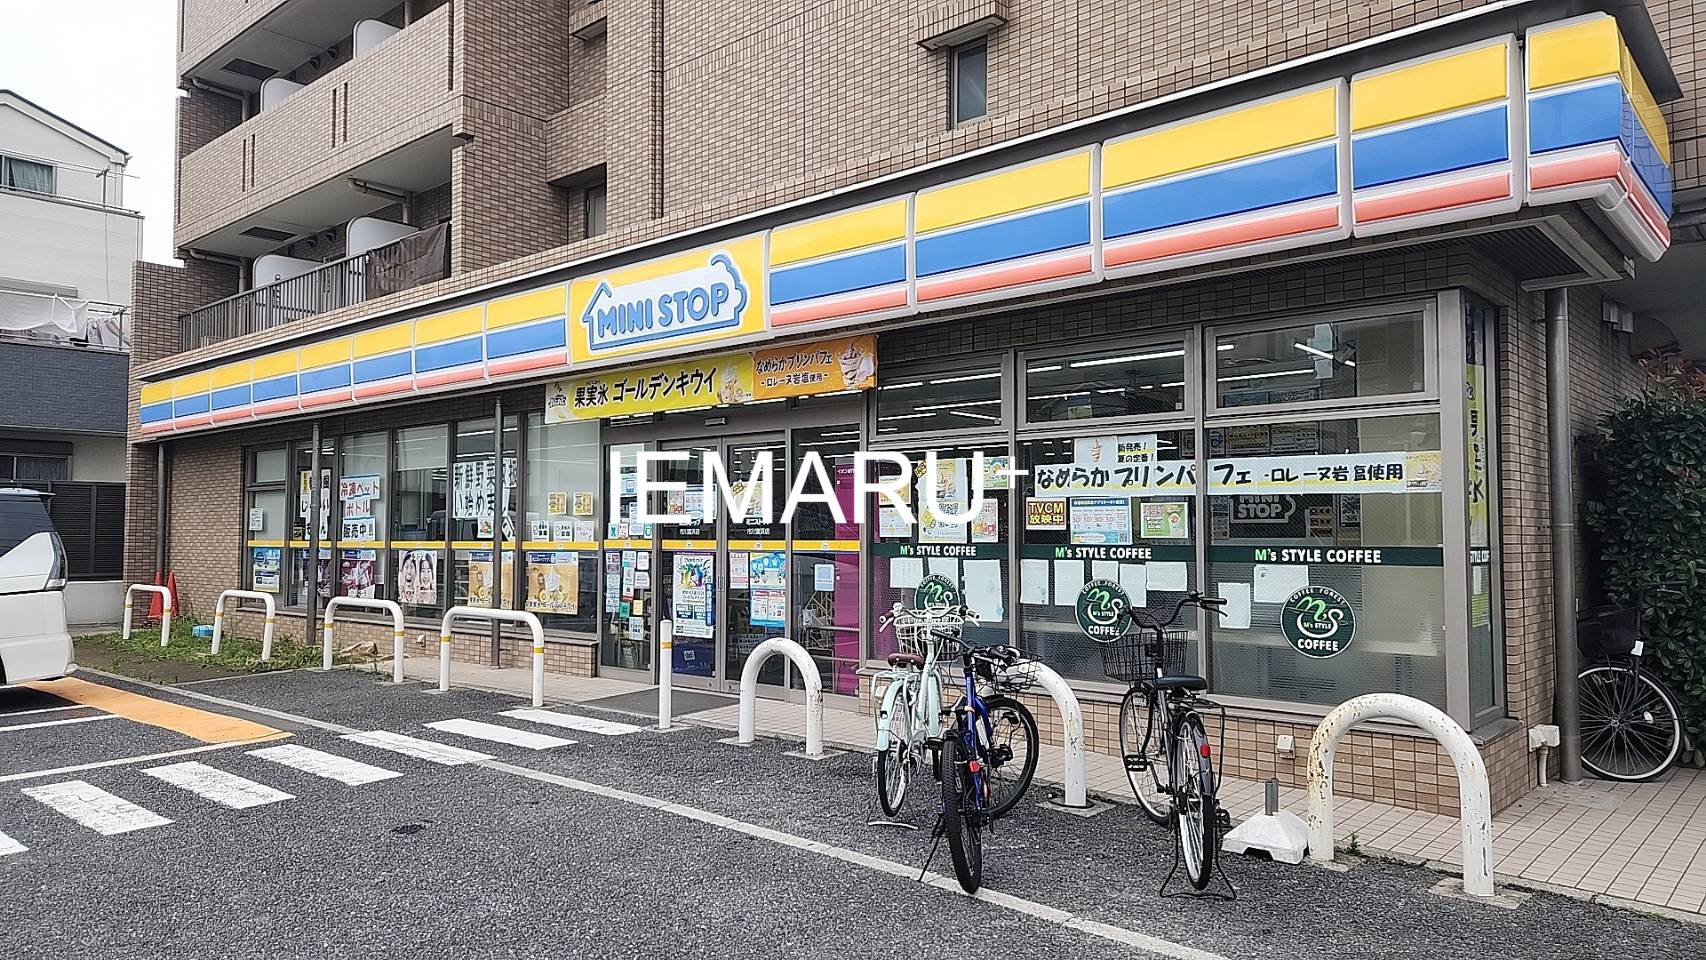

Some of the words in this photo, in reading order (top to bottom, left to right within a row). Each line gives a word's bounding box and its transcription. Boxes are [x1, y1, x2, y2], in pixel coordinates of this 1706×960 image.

[596, 298, 653, 338] MINI
[658, 283, 730, 327] STOP
[756, 350, 833, 375] なめらかプリンパフェ
[574, 383, 609, 408] 果実氷
[612, 366, 718, 403] ゴールデンキウイ
[1028, 502, 1065, 514] TVCM
[1237, 504, 1282, 519] STOP
[1028, 513, 1065, 525] 放映中
[900, 544, 914, 556] M's
[916, 545, 941, 556] STYLE
[943, 545, 977, 557] COFFEE
[1055, 547, 1072, 559] M's
[1075, 547, 1107, 559] STYLE
[1109, 548, 1152, 560] COFFEE
[1254, 548, 1277, 562] M's
[1281, 549, 1322, 563] STYLE
[1326, 549, 1382, 564] COFFEE
[1319, 588, 1346, 606] FOREST
[1088, 625, 1120, 636] COFFEE
[1297, 638, 1339, 652] COFFEE
